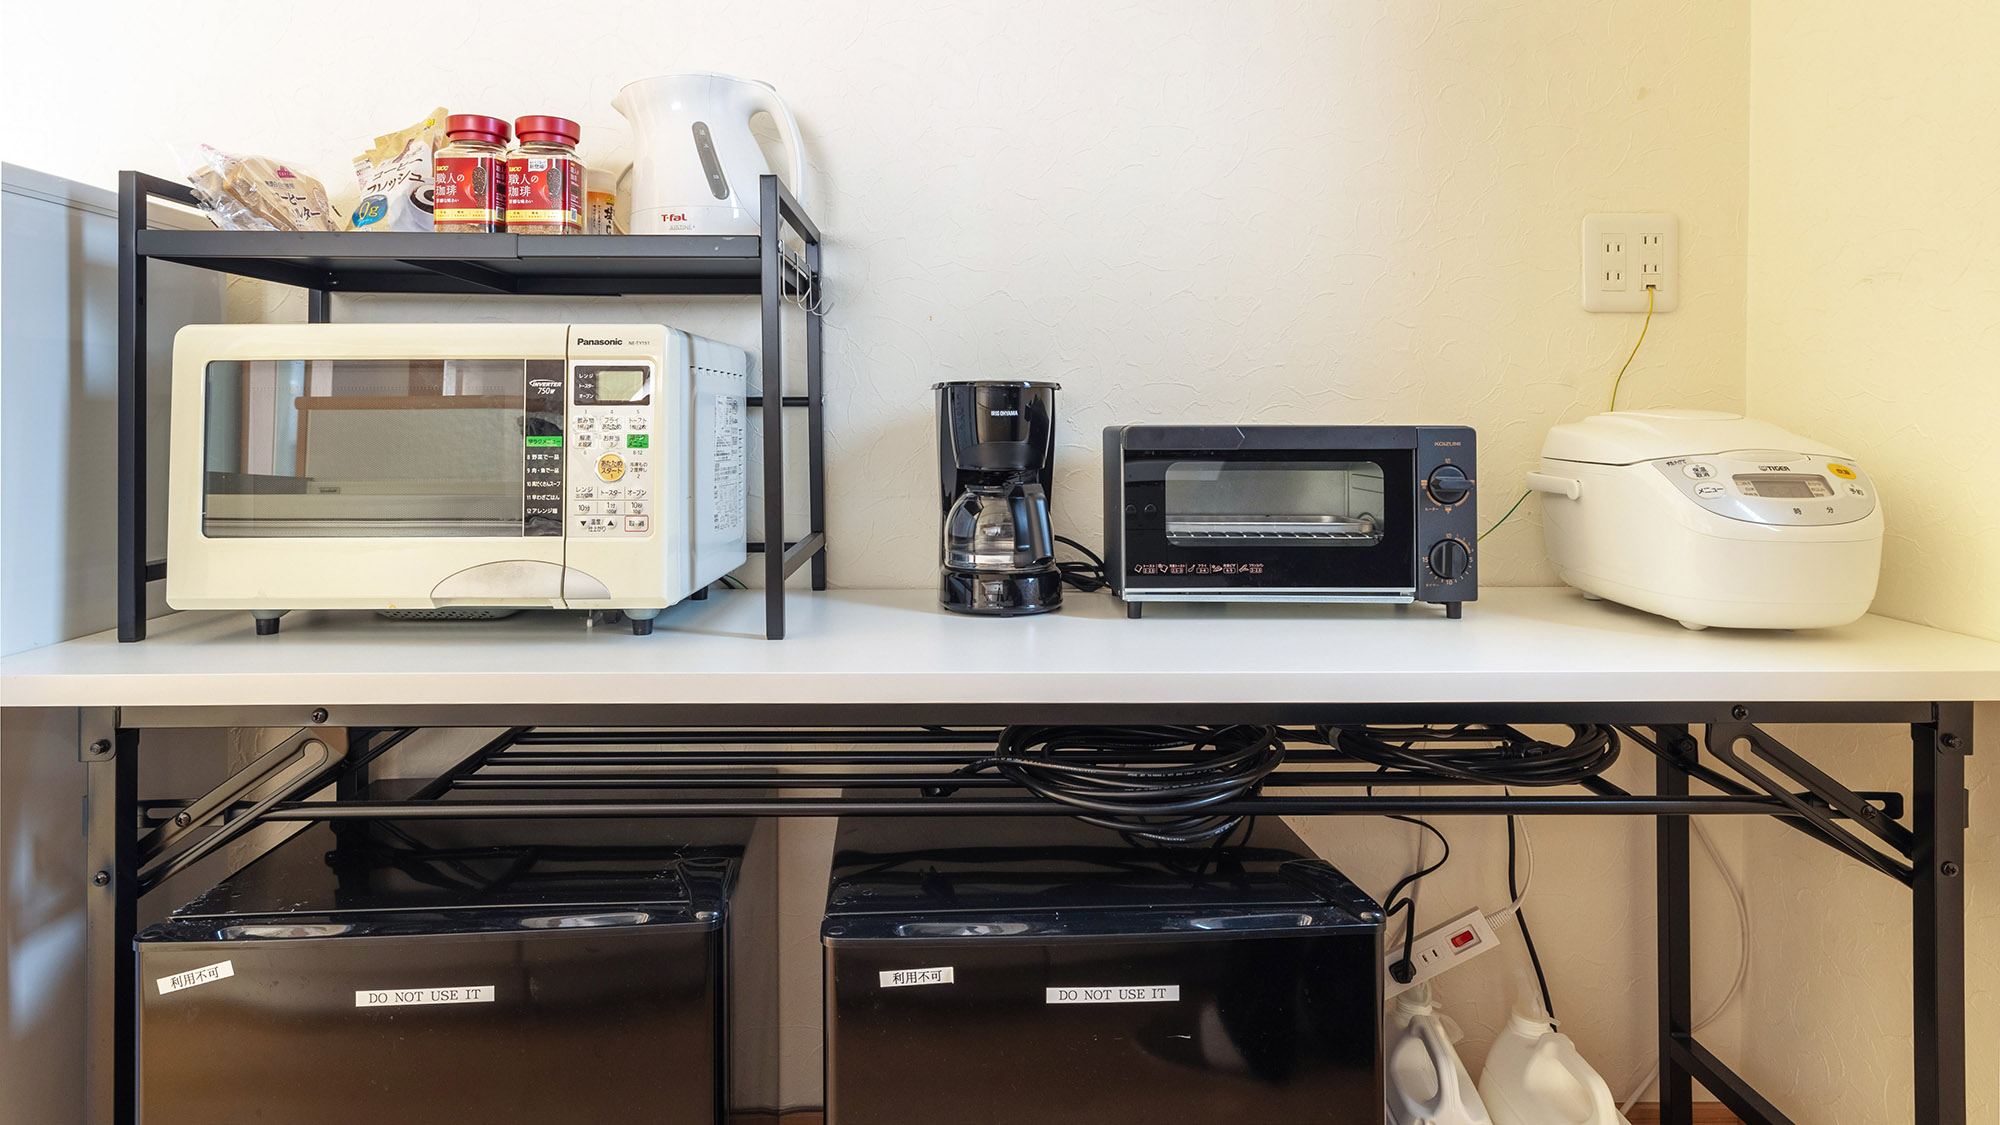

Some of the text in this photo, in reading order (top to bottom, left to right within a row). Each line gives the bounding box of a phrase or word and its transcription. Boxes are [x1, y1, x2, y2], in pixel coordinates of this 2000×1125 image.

[372, 158, 423, 181] コーヒー
[367, 170, 426, 194] フレッシュ
[436, 173, 465, 184] 職人の
[508, 173, 539, 185] 職人の
[436, 185, 457, 196] 珈琲
[508, 185, 531, 197] 珈琲
[358, 201, 380, 220] 0g
[577, 338, 623, 346] Panasonic
[1698, 486, 1724, 495] メニュー
[1793, 507, 1802, 515] 時
[1826, 506, 1834, 514] 分
[170, 966, 219, 989] 利用不可
[892, 970, 942, 984] 利用不可
[369, 989, 481, 1003] DO NOT USE IT
[1058, 988, 1166, 1001] DO NOT USE IT
